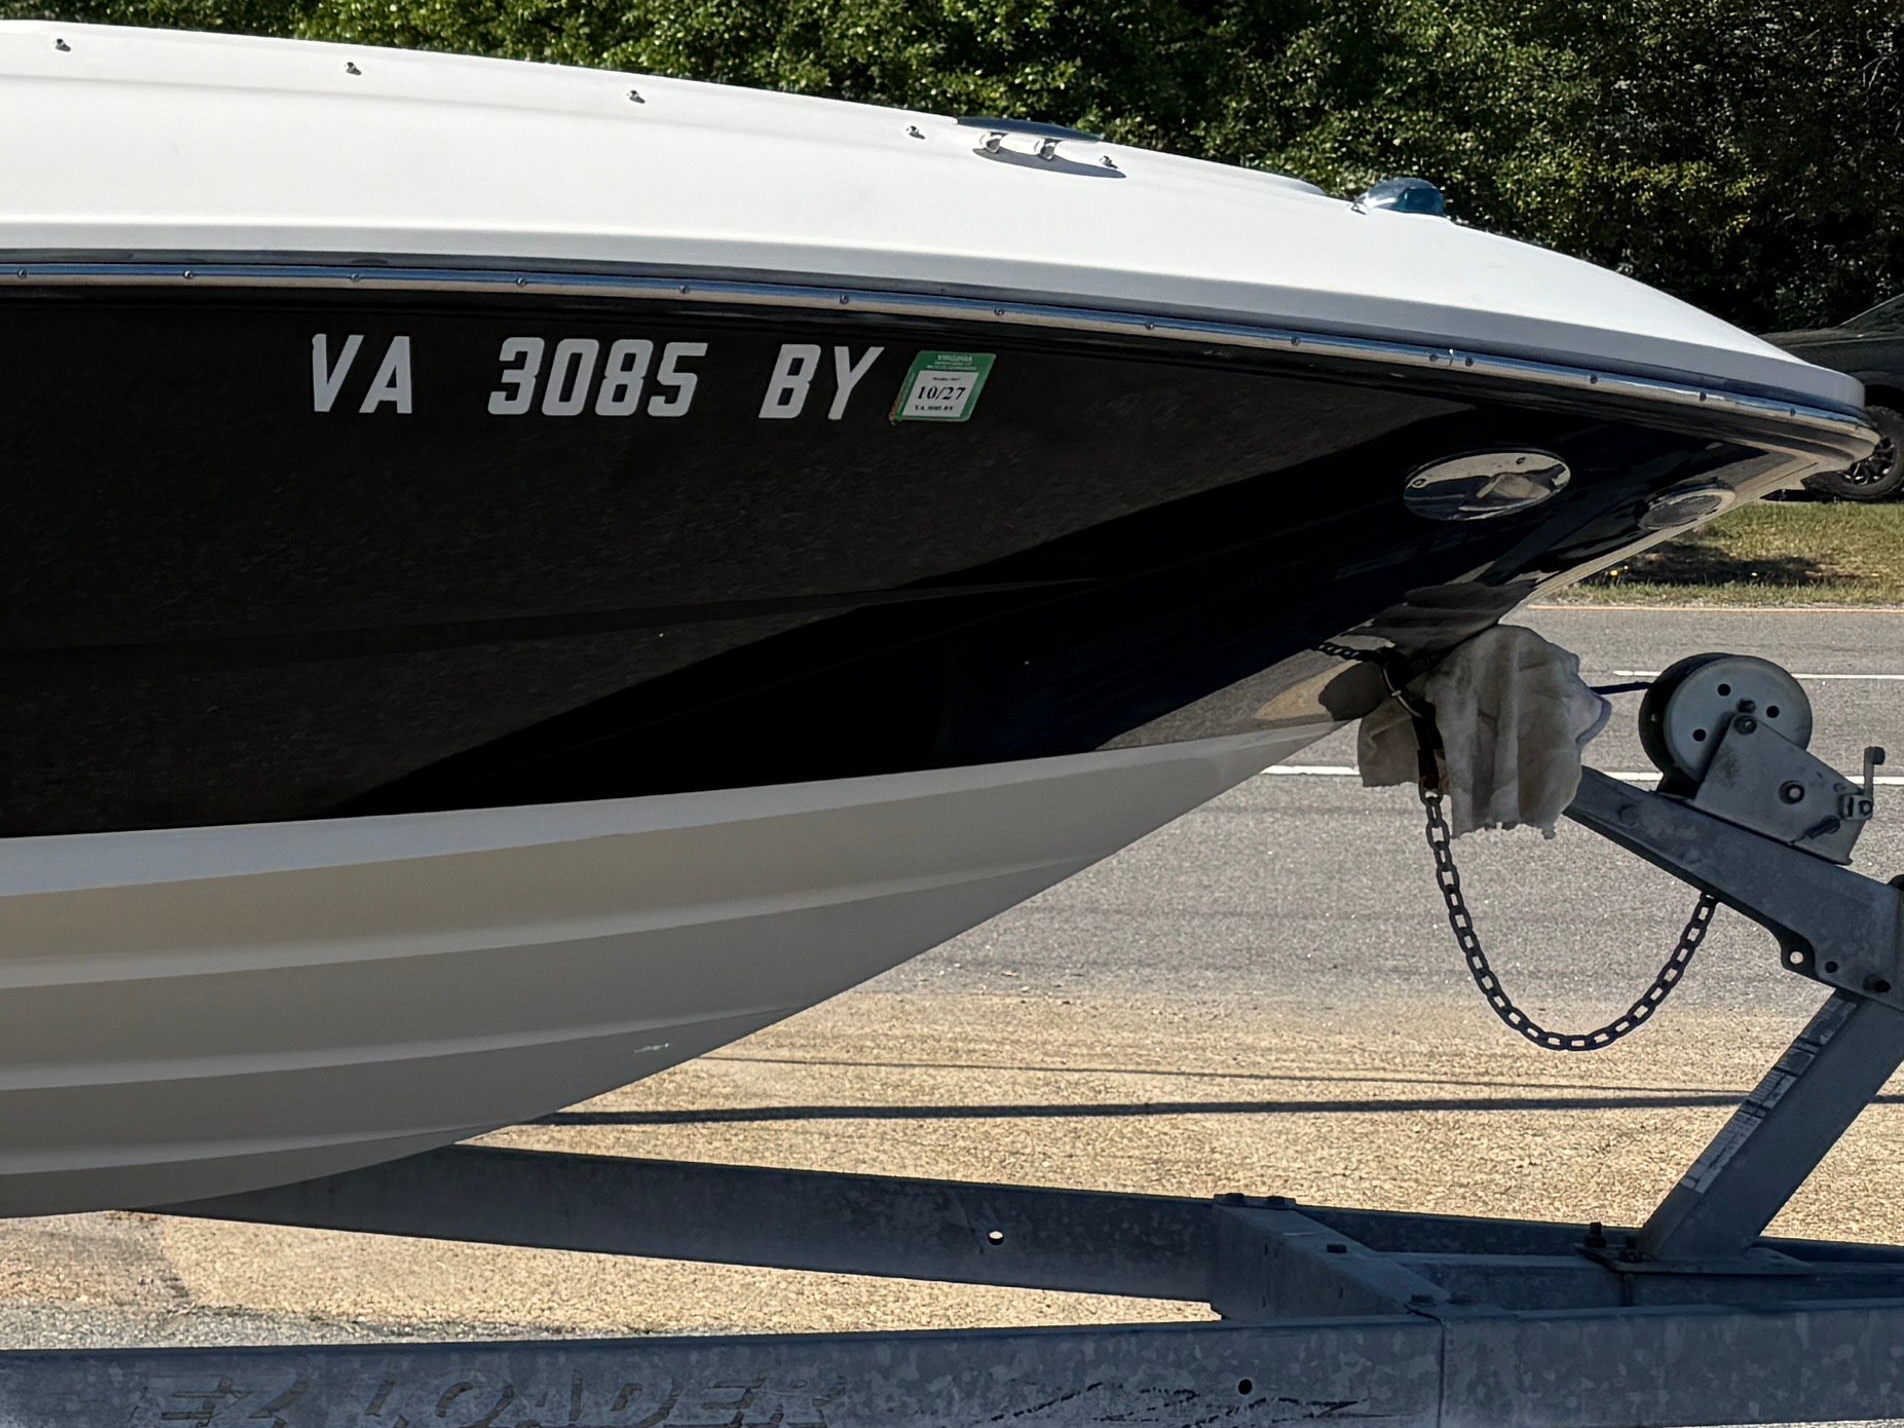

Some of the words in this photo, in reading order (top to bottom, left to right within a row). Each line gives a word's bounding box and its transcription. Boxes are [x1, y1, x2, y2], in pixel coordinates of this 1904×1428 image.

[311, 333, 413, 415] VA
[487, 337, 708, 417] 3085
[758, 344, 885, 420] BY
[918, 385, 967, 401] 10/27
